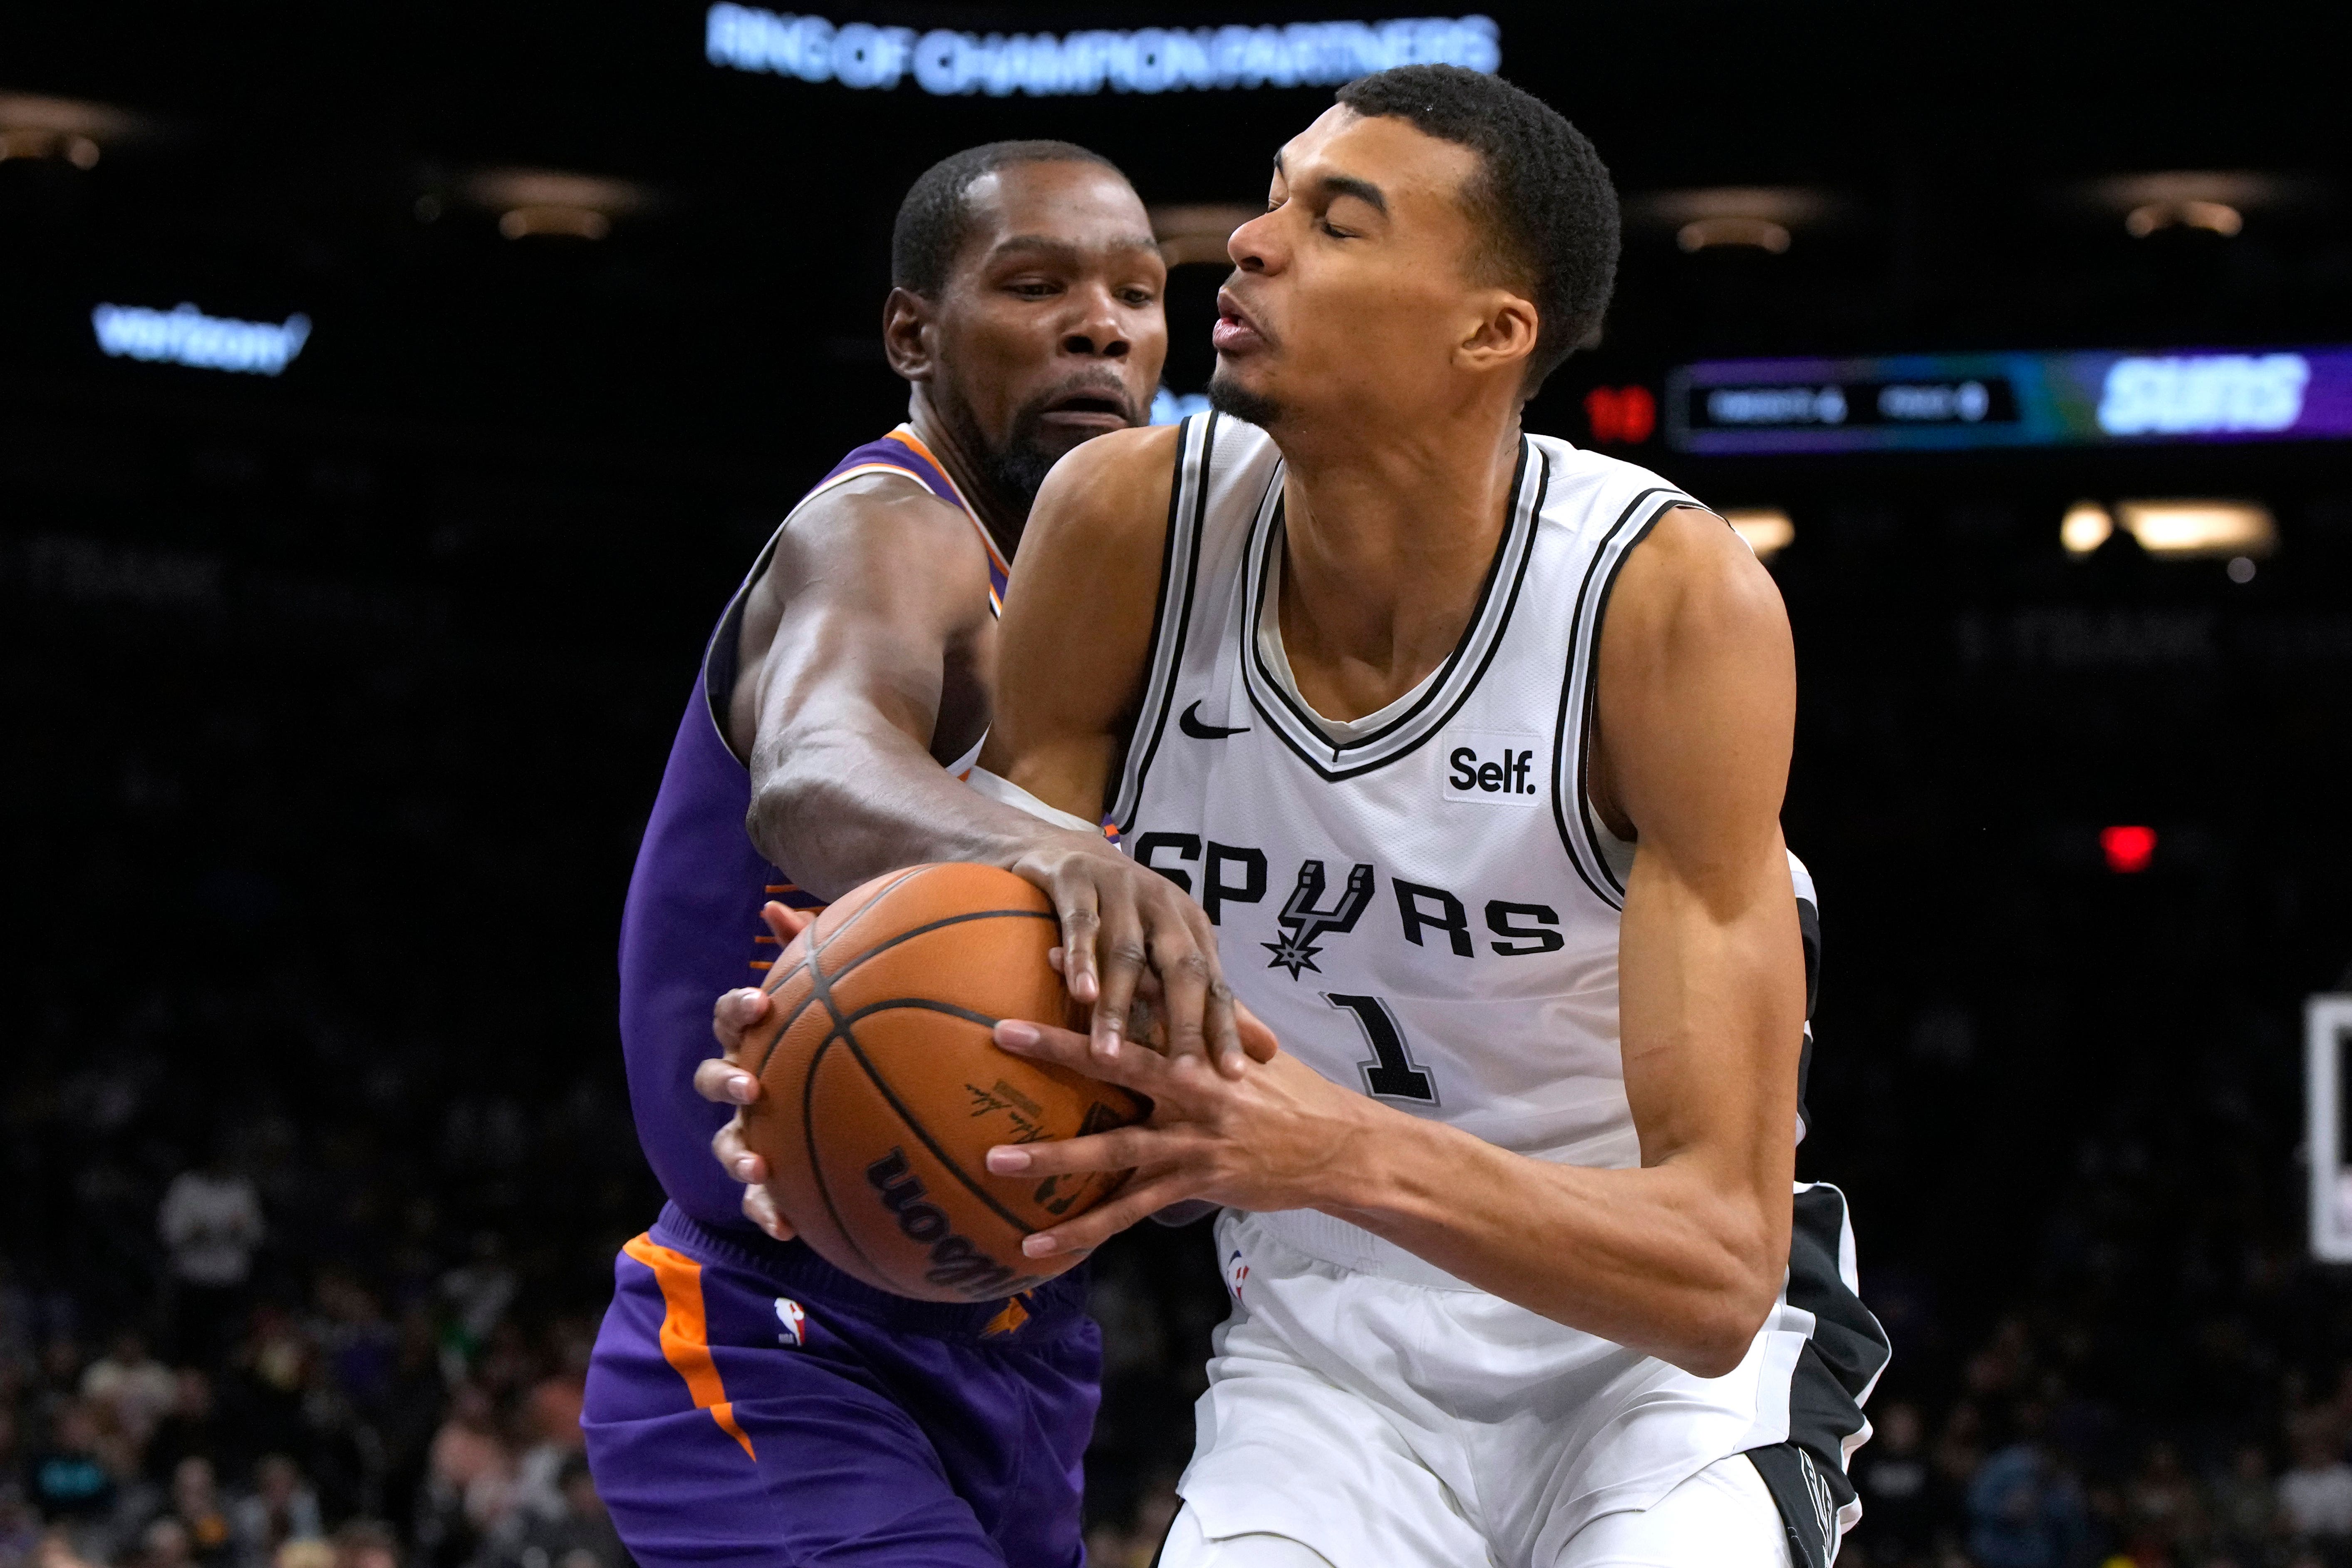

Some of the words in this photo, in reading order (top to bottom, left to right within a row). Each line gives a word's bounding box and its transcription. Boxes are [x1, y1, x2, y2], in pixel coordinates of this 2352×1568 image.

[706, 1, 833, 82] RING
[832, 22, 914, 89] OF
[914, 27, 1210, 97] CHAMPION
[92, 301, 292, 376] verizon
[1450, 747, 1536, 795] Self.
[1134, 832, 1564, 982] SPURS
[1318, 991, 1441, 1107] 1
